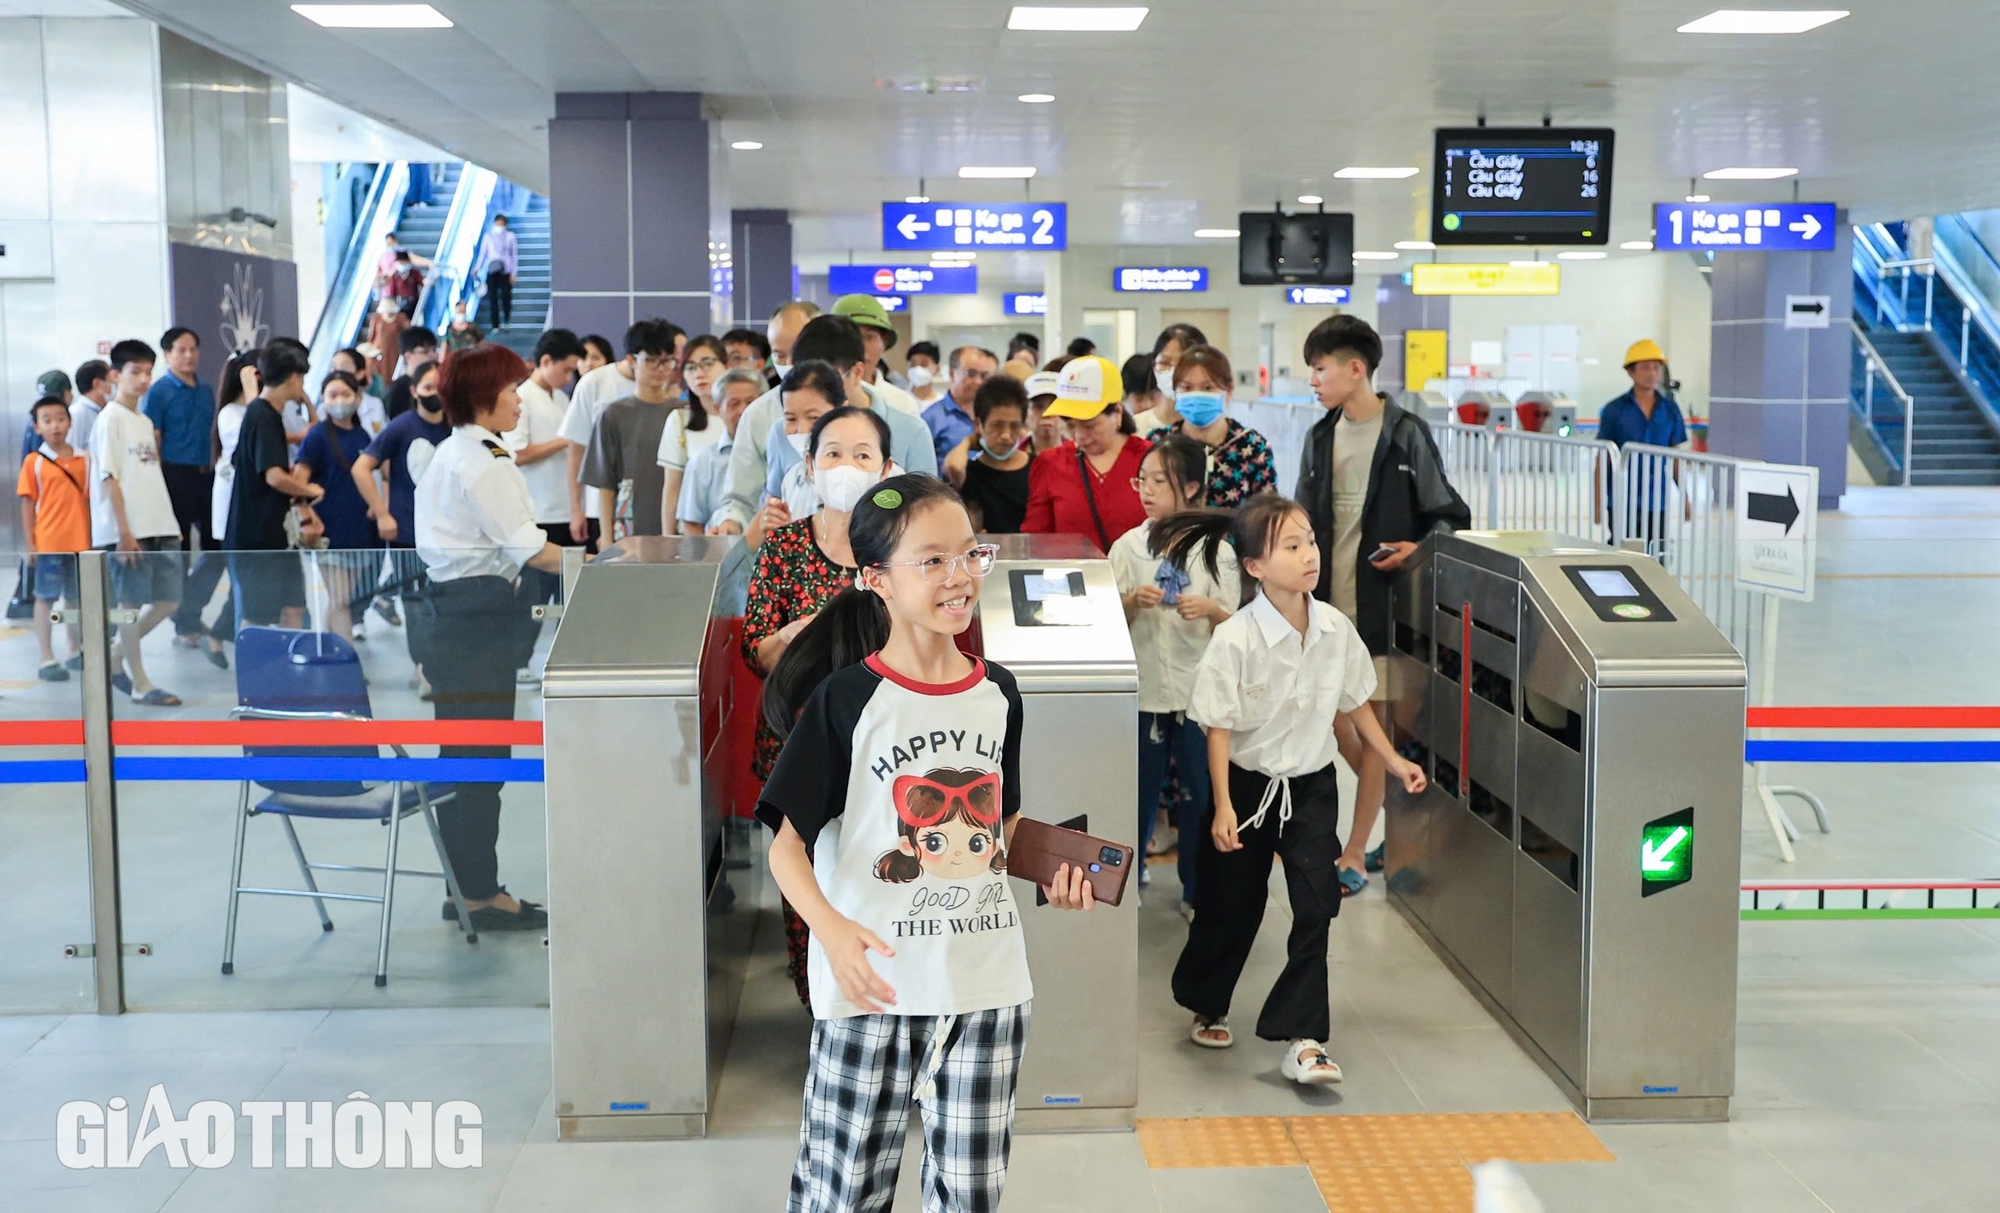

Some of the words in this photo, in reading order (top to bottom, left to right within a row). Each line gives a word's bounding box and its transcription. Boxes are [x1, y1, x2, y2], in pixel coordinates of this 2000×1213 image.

[1586, 155, 1596, 169] 6
[1445, 169, 1452, 183] 1
[1582, 169, 1599, 183] 16
[1444, 184, 1452, 197] 1
[1580, 183, 1598, 198] 26
[1032, 209, 1054, 245] 2
[1669, 210, 1683, 244] 1
[871, 730, 966, 782] HAPPY
[891, 919, 942, 938] THE
[948, 911, 1018, 935] WORLD
